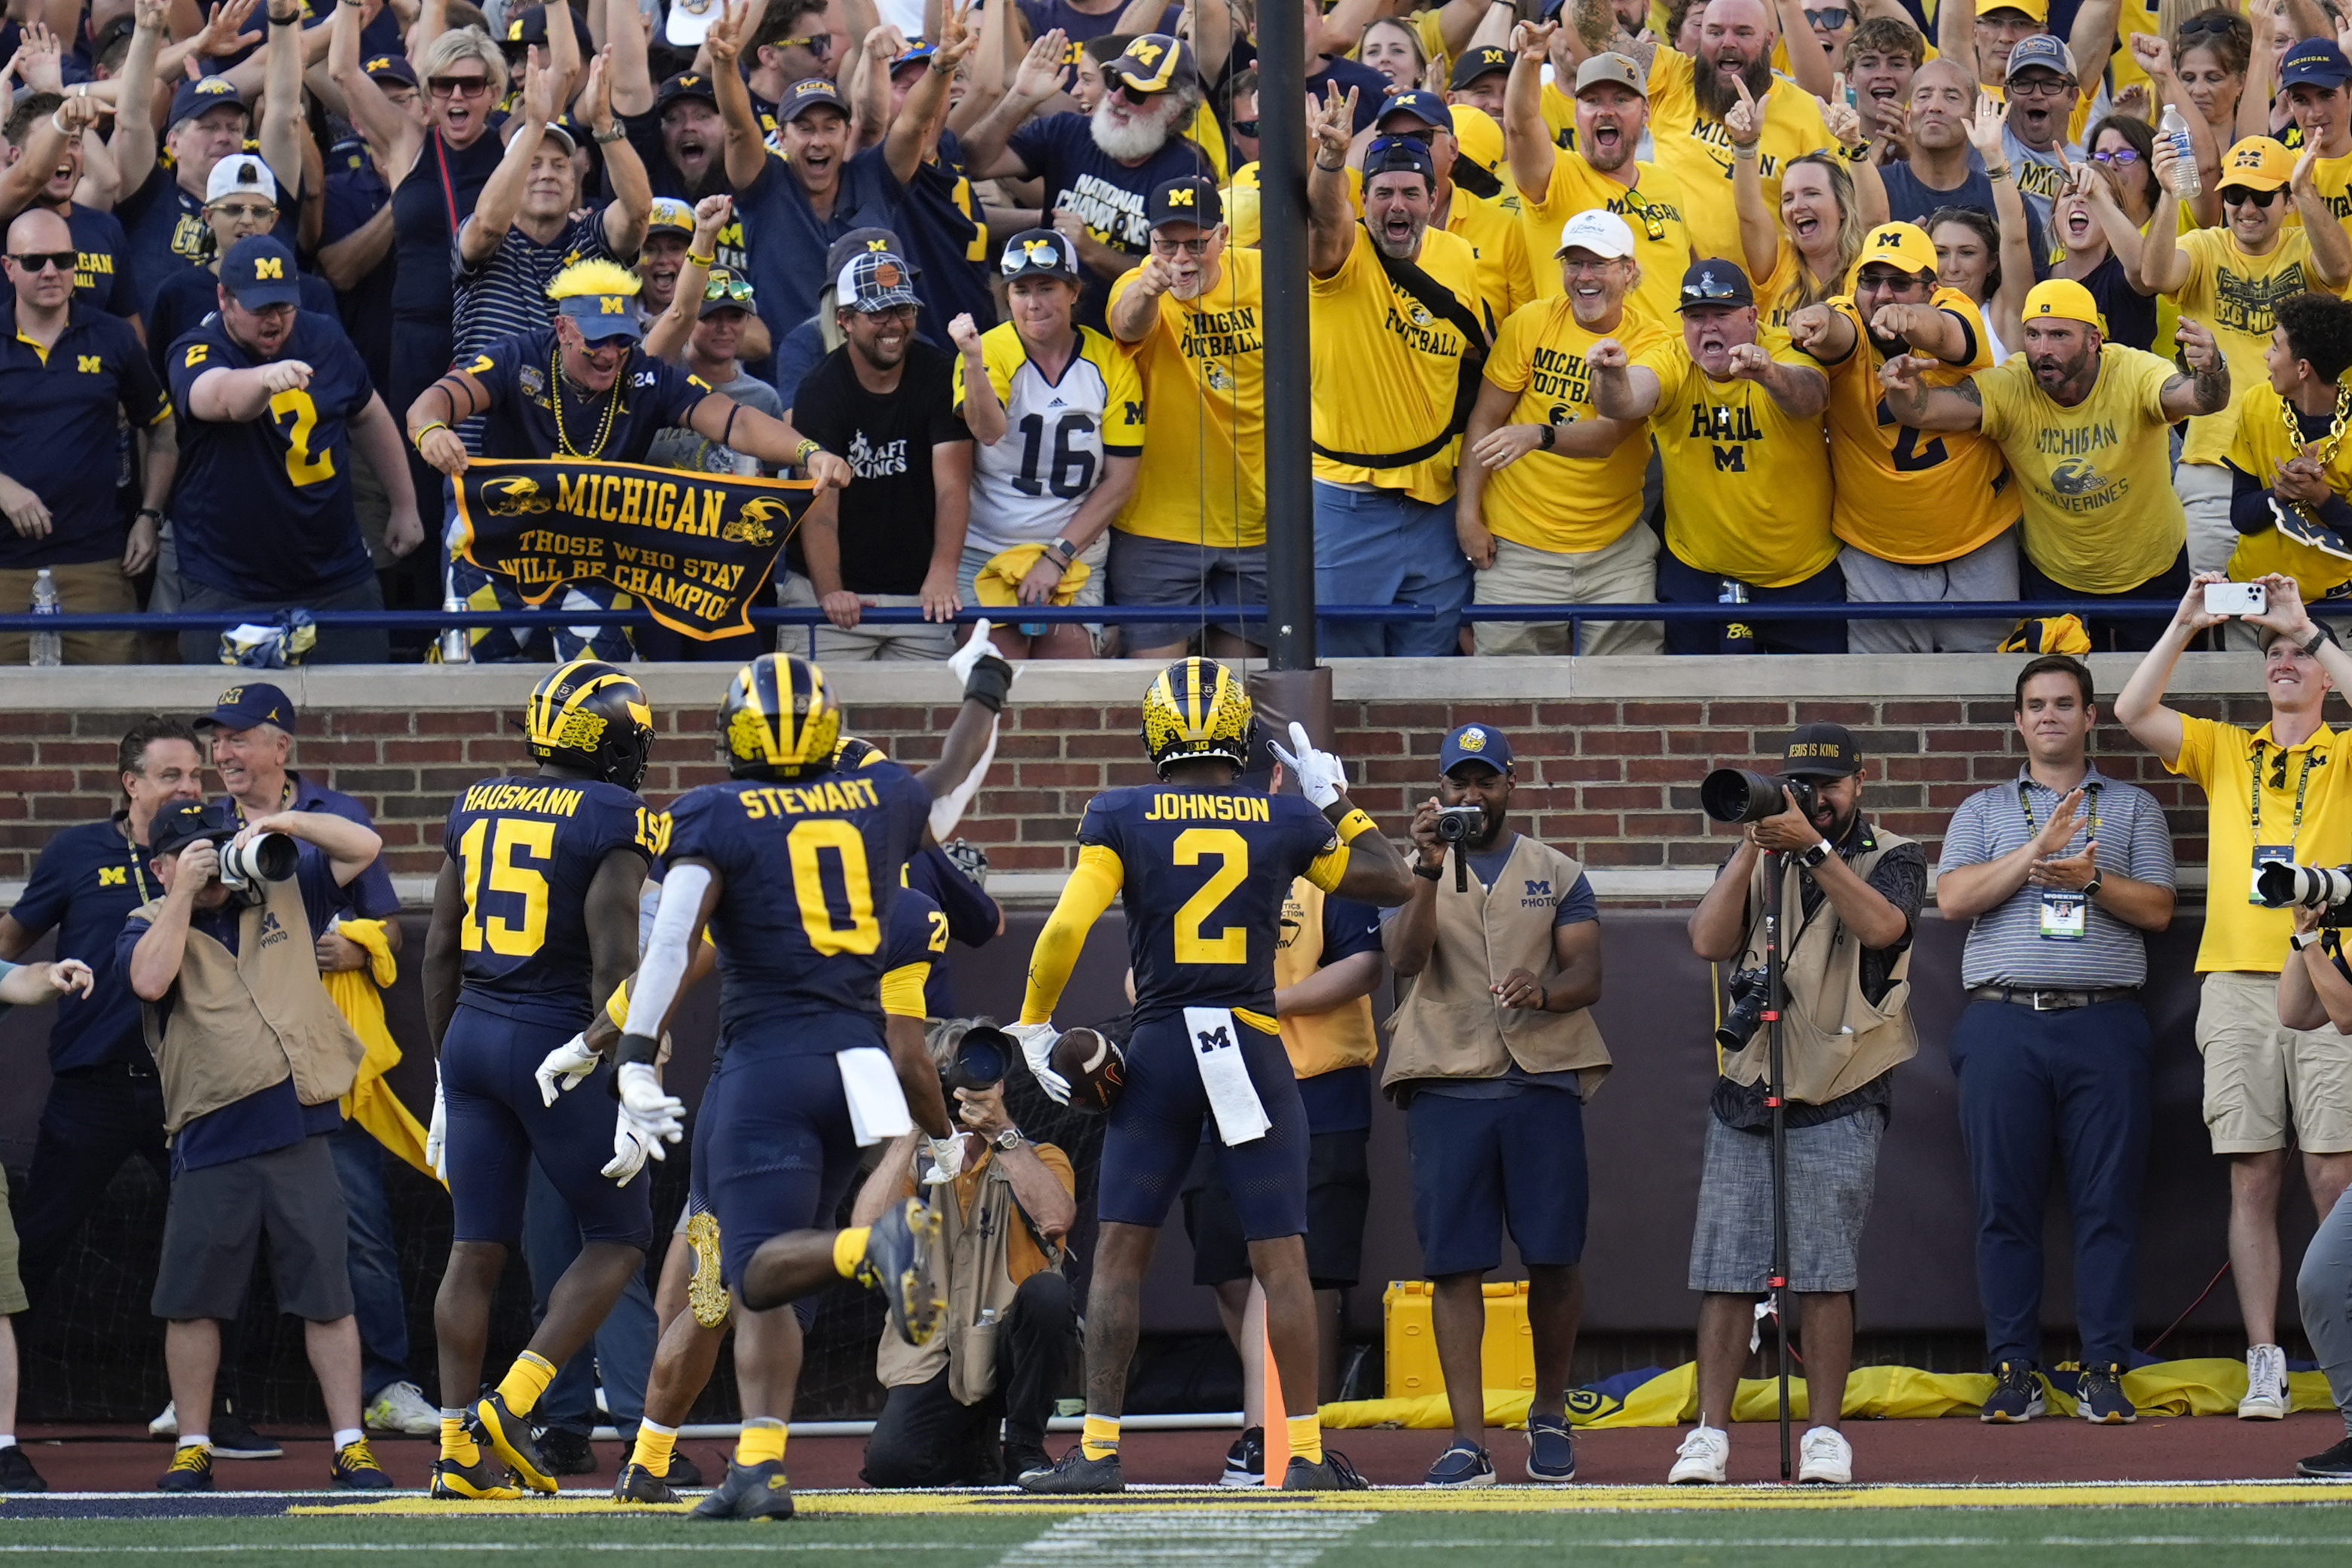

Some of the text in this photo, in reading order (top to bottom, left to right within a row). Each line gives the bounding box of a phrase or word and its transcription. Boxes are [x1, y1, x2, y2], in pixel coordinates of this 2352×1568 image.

[1127, 39, 1164, 66] M
[1482, 50, 1505, 63] M
[1395, 94, 1417, 105] M
[1073, 172, 1145, 218] NATIONAL
[1168, 188, 1194, 207] M
[867, 239, 887, 252] M
[1877, 233, 1902, 247] M
[254, 256, 283, 280] M
[600, 295, 624, 315] M
[2215, 299, 2244, 325] BIG
[78, 355, 102, 374] M
[185, 344, 210, 368] 2
[1532, 346, 1593, 381] MICHI
[1124, 401, 1145, 425] M
[268, 389, 337, 487] 2
[851, 456, 908, 479] KINGS
[1011, 413, 1096, 499] 16
[1713, 445, 1747, 472] M
[498, 557, 563, 584] WILL
[519, 529, 745, 592] THOSE WHO STAY
[218, 688, 243, 705] M
[1788, 743, 1839, 758] JESUS IS KING
[462, 784, 584, 818] HAUSMANN
[739, 778, 880, 819] STEWART
[1145, 792, 1271, 823] JOHNSON
[98, 866, 127, 886] M
[459, 818, 557, 957] 15
[786, 818, 882, 956] 0
[1524, 880, 1552, 895] M
[1172, 828, 1249, 964] 2
[1521, 896, 1558, 908] PHOTO
[2043, 892, 2085, 901] WORKING
[261, 911, 282, 933] M
[927, 911, 950, 953] 2
[1197, 1026, 1232, 1053] M
